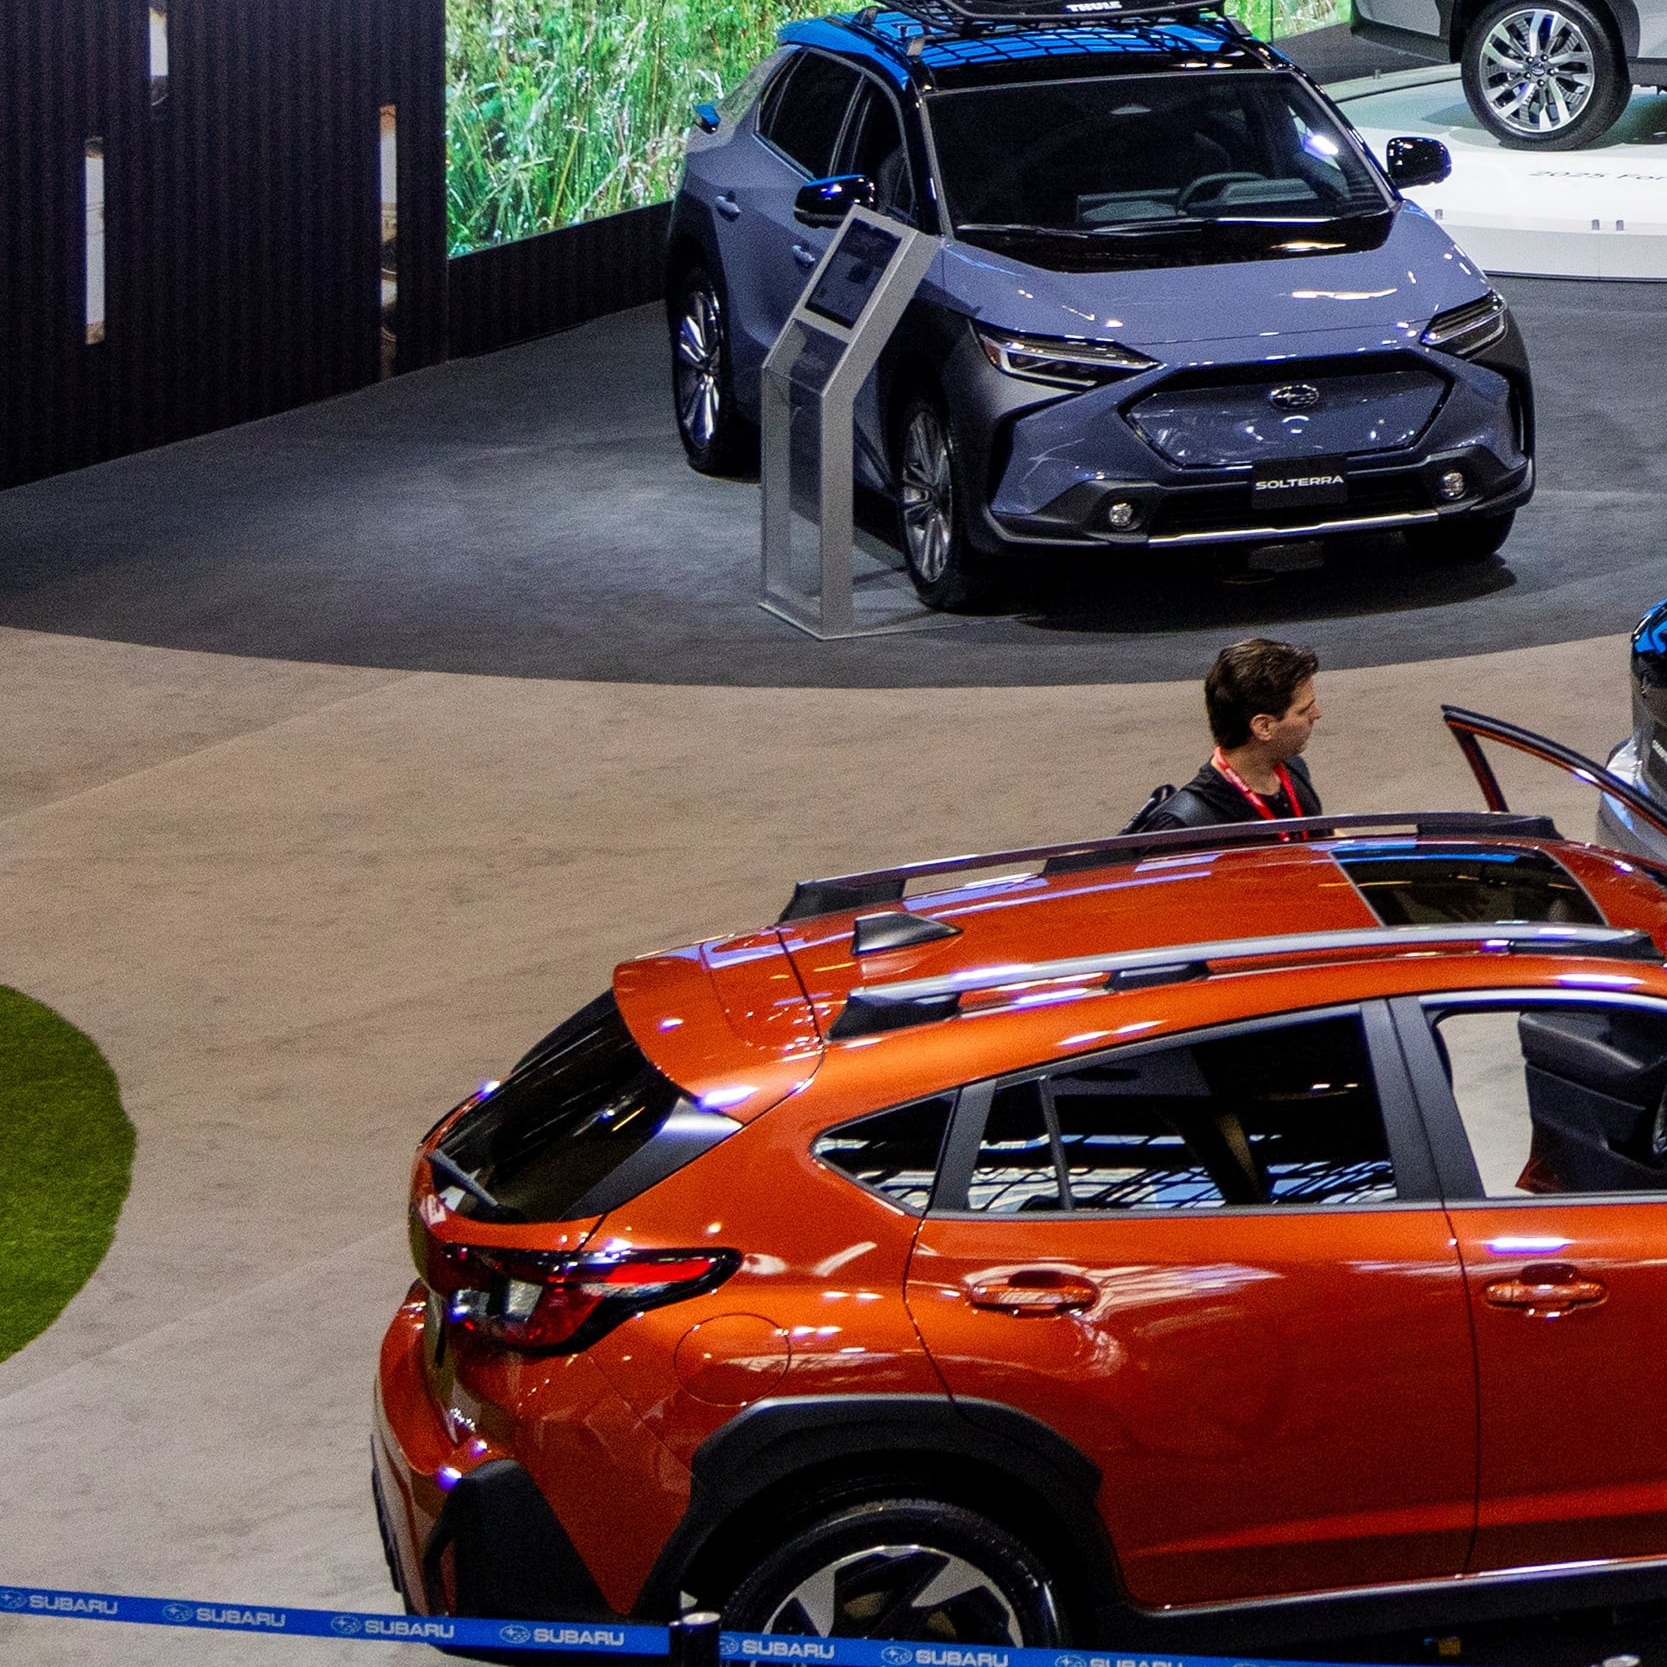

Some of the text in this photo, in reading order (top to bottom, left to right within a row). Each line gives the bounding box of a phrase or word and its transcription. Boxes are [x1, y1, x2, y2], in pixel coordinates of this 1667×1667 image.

[1255, 475, 1344, 490] SOLTERRA
[29, 1594, 118, 1615] SUBARU
[196, 1608, 286, 1627] SUBARU
[364, 1619, 454, 1638] SUBARU
[533, 1628, 624, 1646] SUBARU
[741, 1639, 835, 1658] SUBARU
[915, 1649, 1008, 1667] SUBARU
